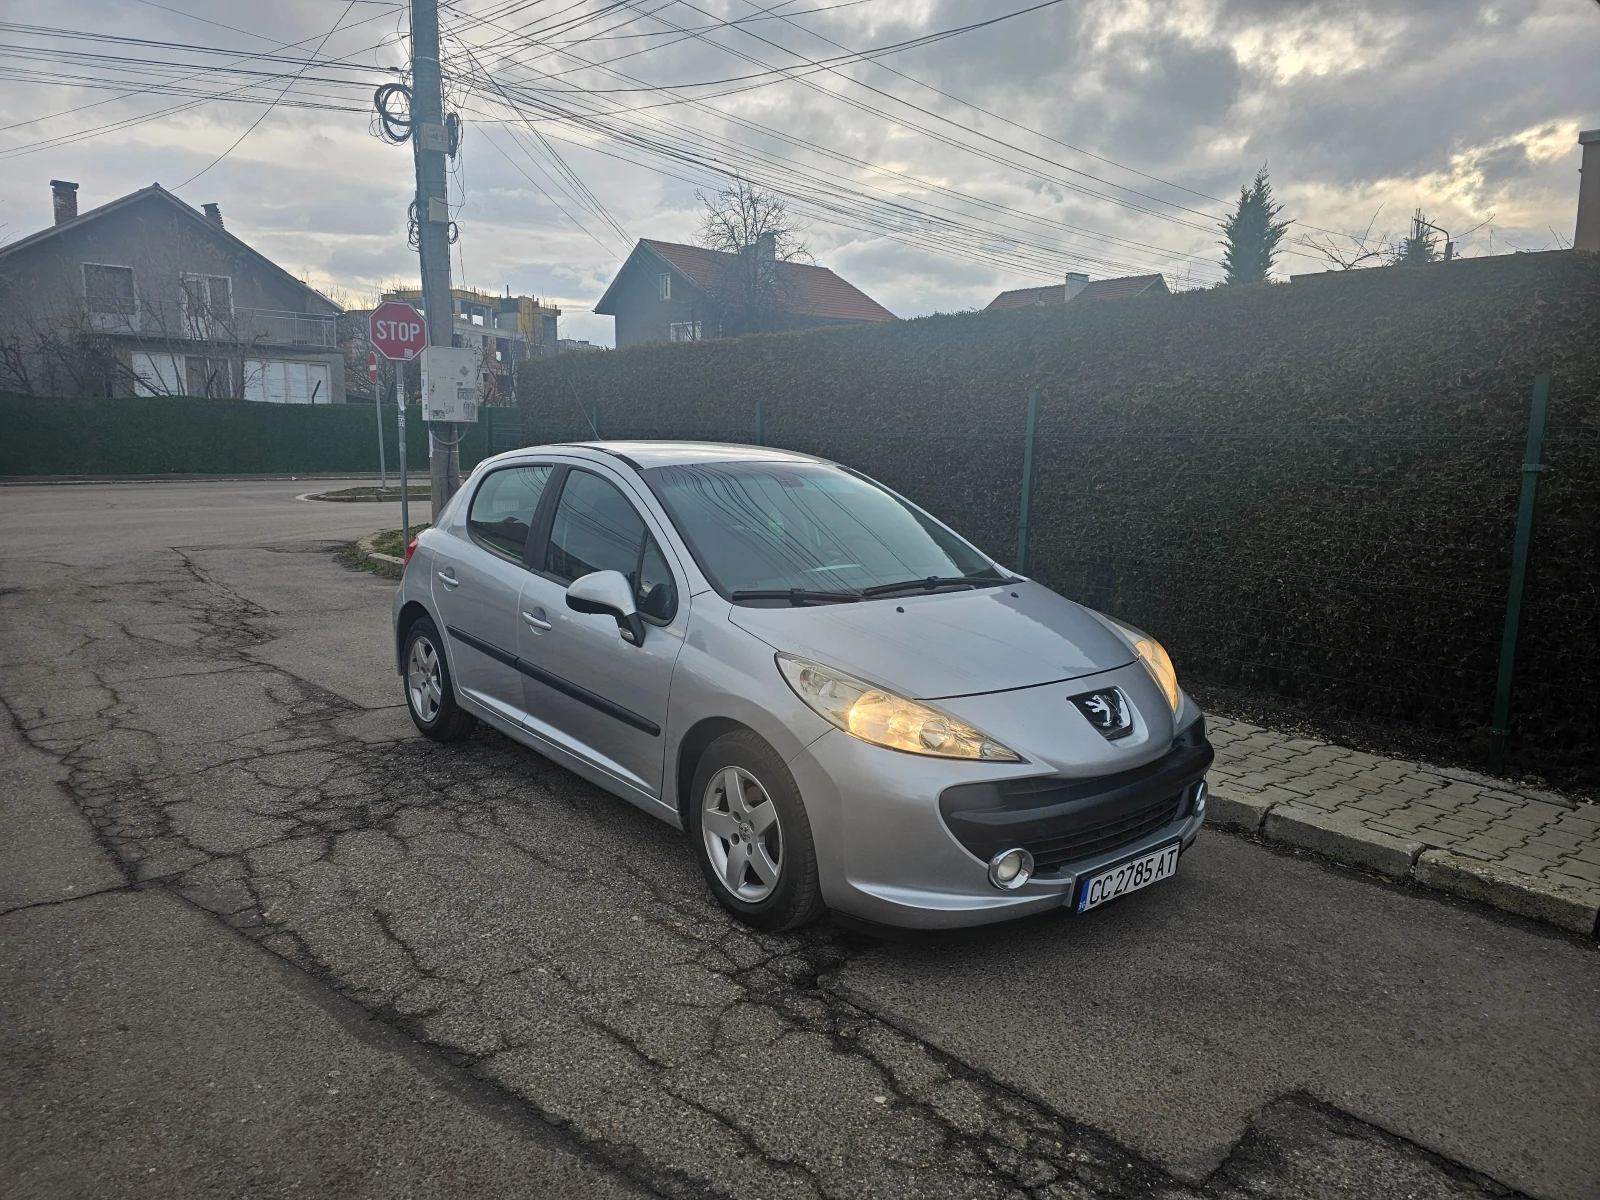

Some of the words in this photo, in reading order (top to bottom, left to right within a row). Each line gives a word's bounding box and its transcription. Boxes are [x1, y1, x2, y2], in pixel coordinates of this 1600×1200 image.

[376, 320, 420, 342] STOP
[1089, 874, 1113, 905] CC
[1114, 857, 1154, 896] 2785
[1155, 848, 1177, 879] AT
